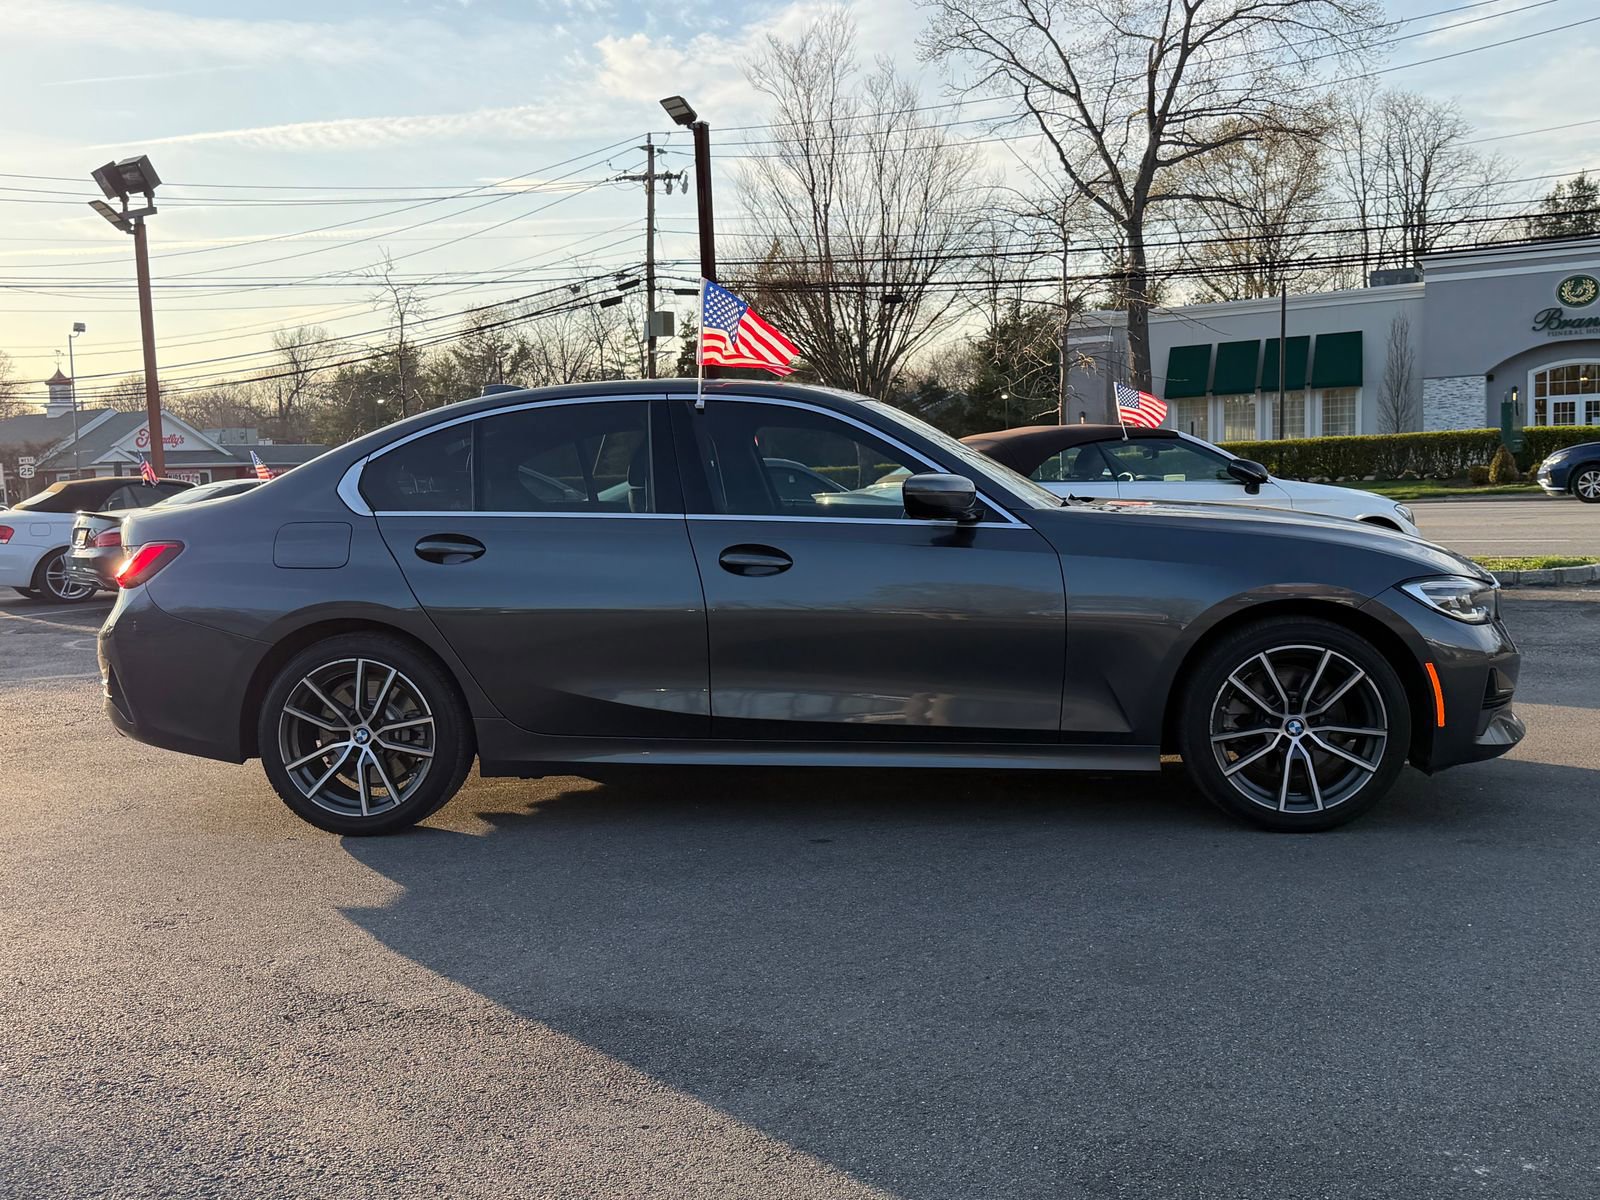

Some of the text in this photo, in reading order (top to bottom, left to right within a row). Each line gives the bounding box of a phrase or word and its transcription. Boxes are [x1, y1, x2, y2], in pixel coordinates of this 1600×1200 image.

[1547, 327, 1600, 337] FUNERAL HO
[20, 467, 33, 476] 25
